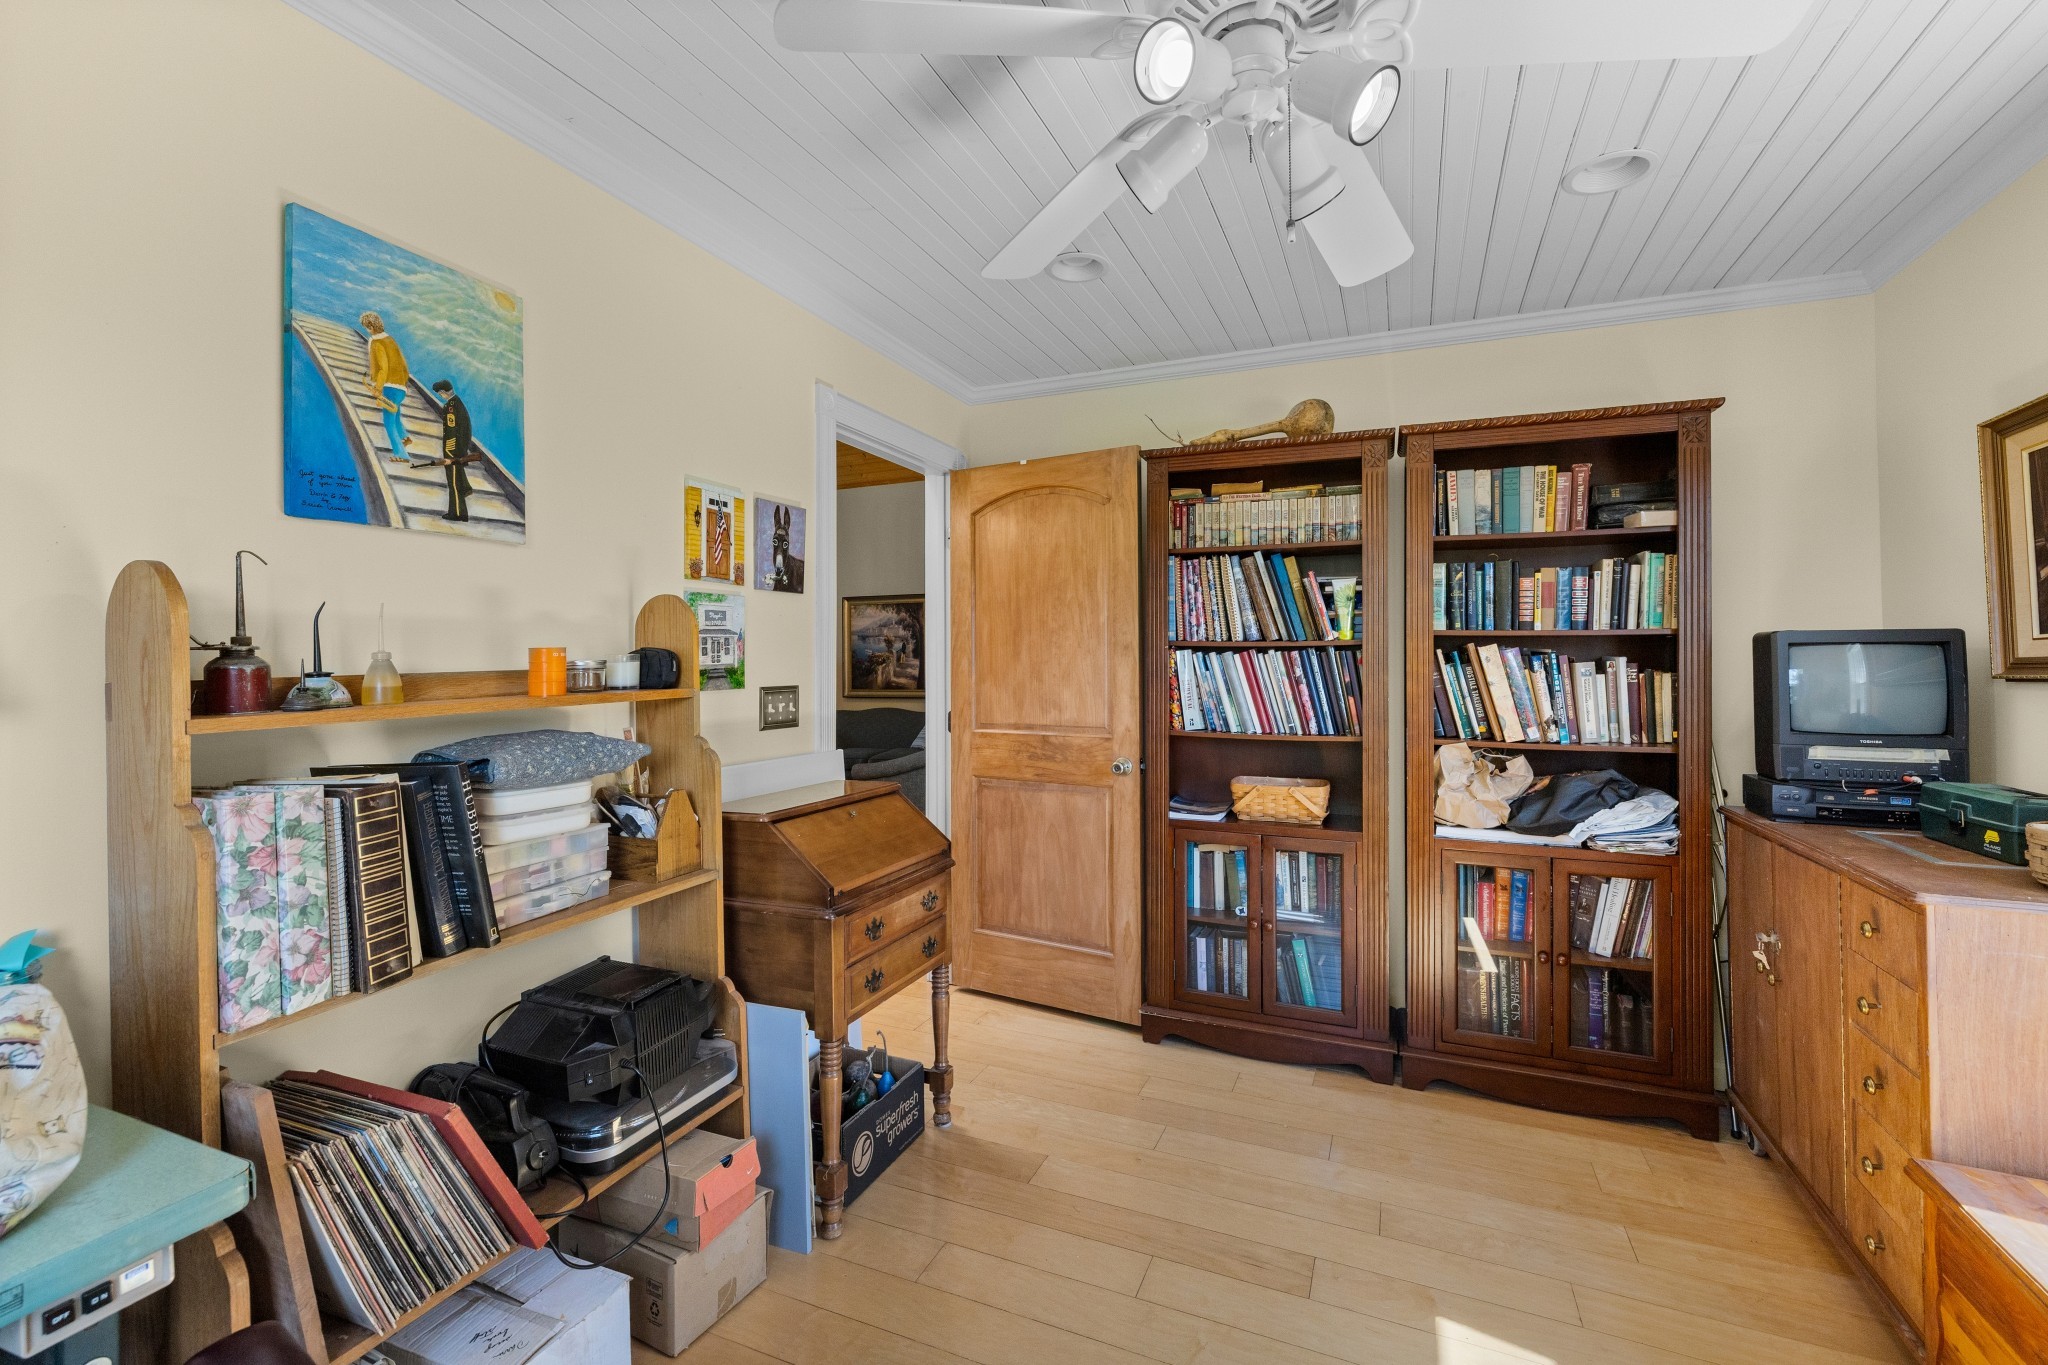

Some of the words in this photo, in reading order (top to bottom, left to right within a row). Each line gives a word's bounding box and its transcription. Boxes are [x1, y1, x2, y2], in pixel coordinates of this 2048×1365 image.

[1465, 666, 1475, 690] HOSTILE
[1472, 688, 1485, 718] TAKEOVER
[461, 780, 485, 858] HUBBLE
[423, 800, 438, 840] BEDFORD
[438, 874, 454, 921] TENNESSEE
[1607, 891, 1619, 913] Healing
[1510, 993, 1521, 1021] FACTS
[875, 1090, 919, 1138] superfresh
[887, 1107, 919, 1147] growers
[51, 1310, 71, 1326] OFF
[90, 1292, 109, 1306] ON
